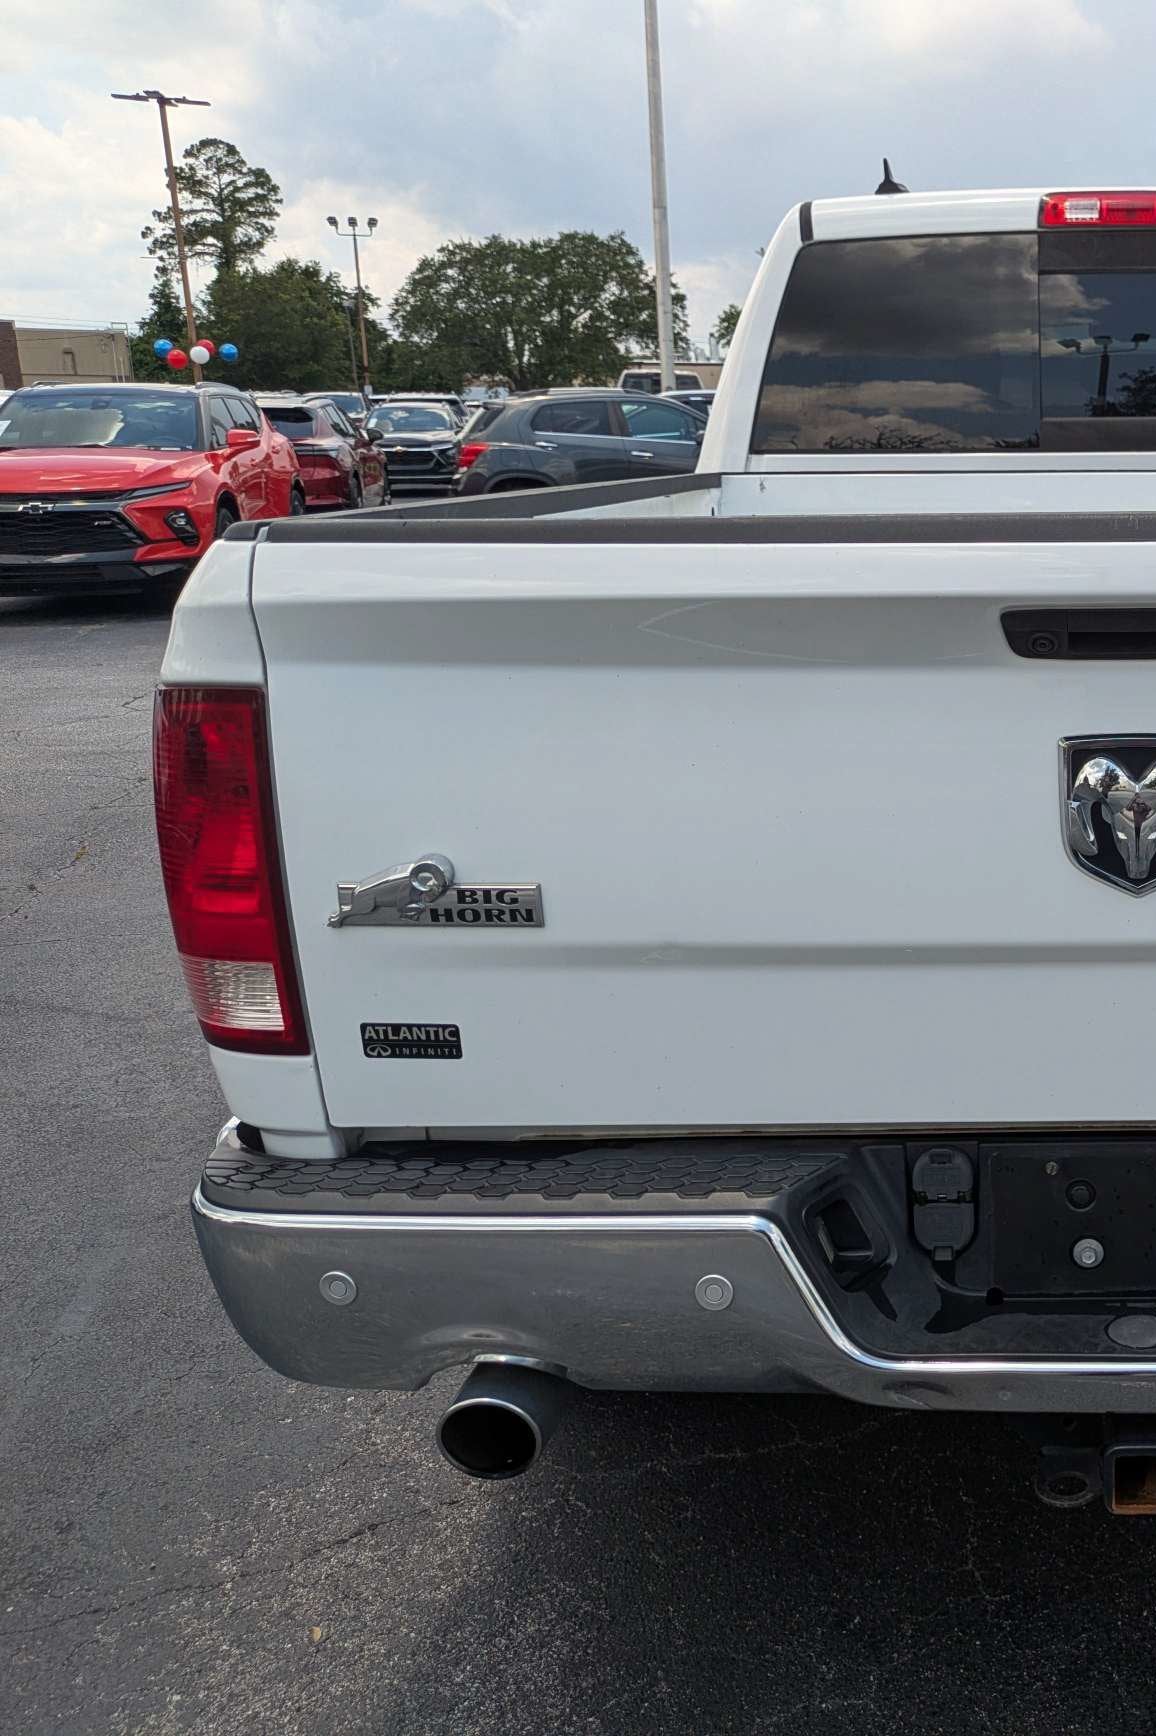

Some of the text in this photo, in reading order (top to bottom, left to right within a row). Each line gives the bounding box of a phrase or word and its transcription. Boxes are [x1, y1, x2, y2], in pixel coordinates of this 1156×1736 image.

[456, 889, 519, 905] BIG
[429, 908, 536, 923] HORN
[364, 1025, 457, 1041] ATLANTIC
[395, 1047, 457, 1056] INFINITI
